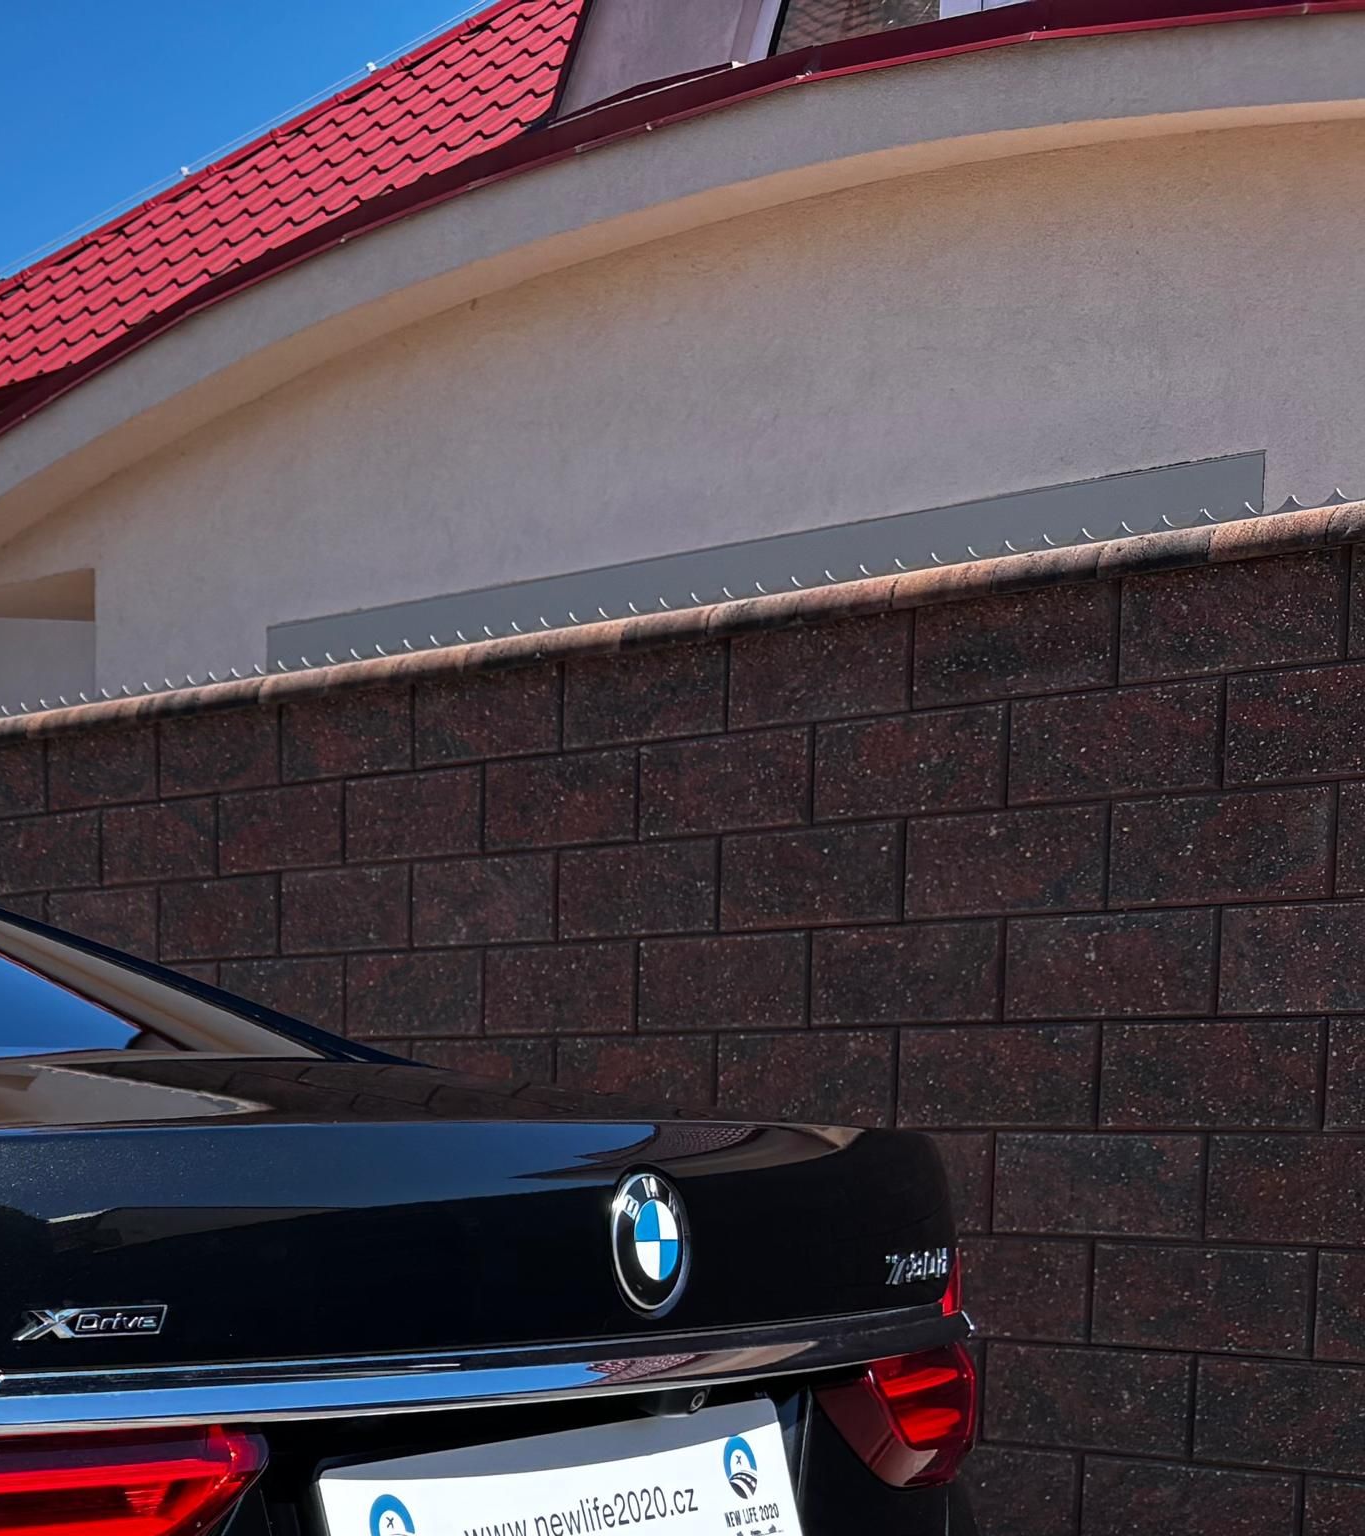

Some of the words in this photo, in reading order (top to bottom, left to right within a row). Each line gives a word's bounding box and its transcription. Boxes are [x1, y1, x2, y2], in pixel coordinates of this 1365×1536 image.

[724, 1510, 742, 1528] NEW
[742, 1506, 759, 1524] LIFE
[758, 1502, 779, 1521] 2020
